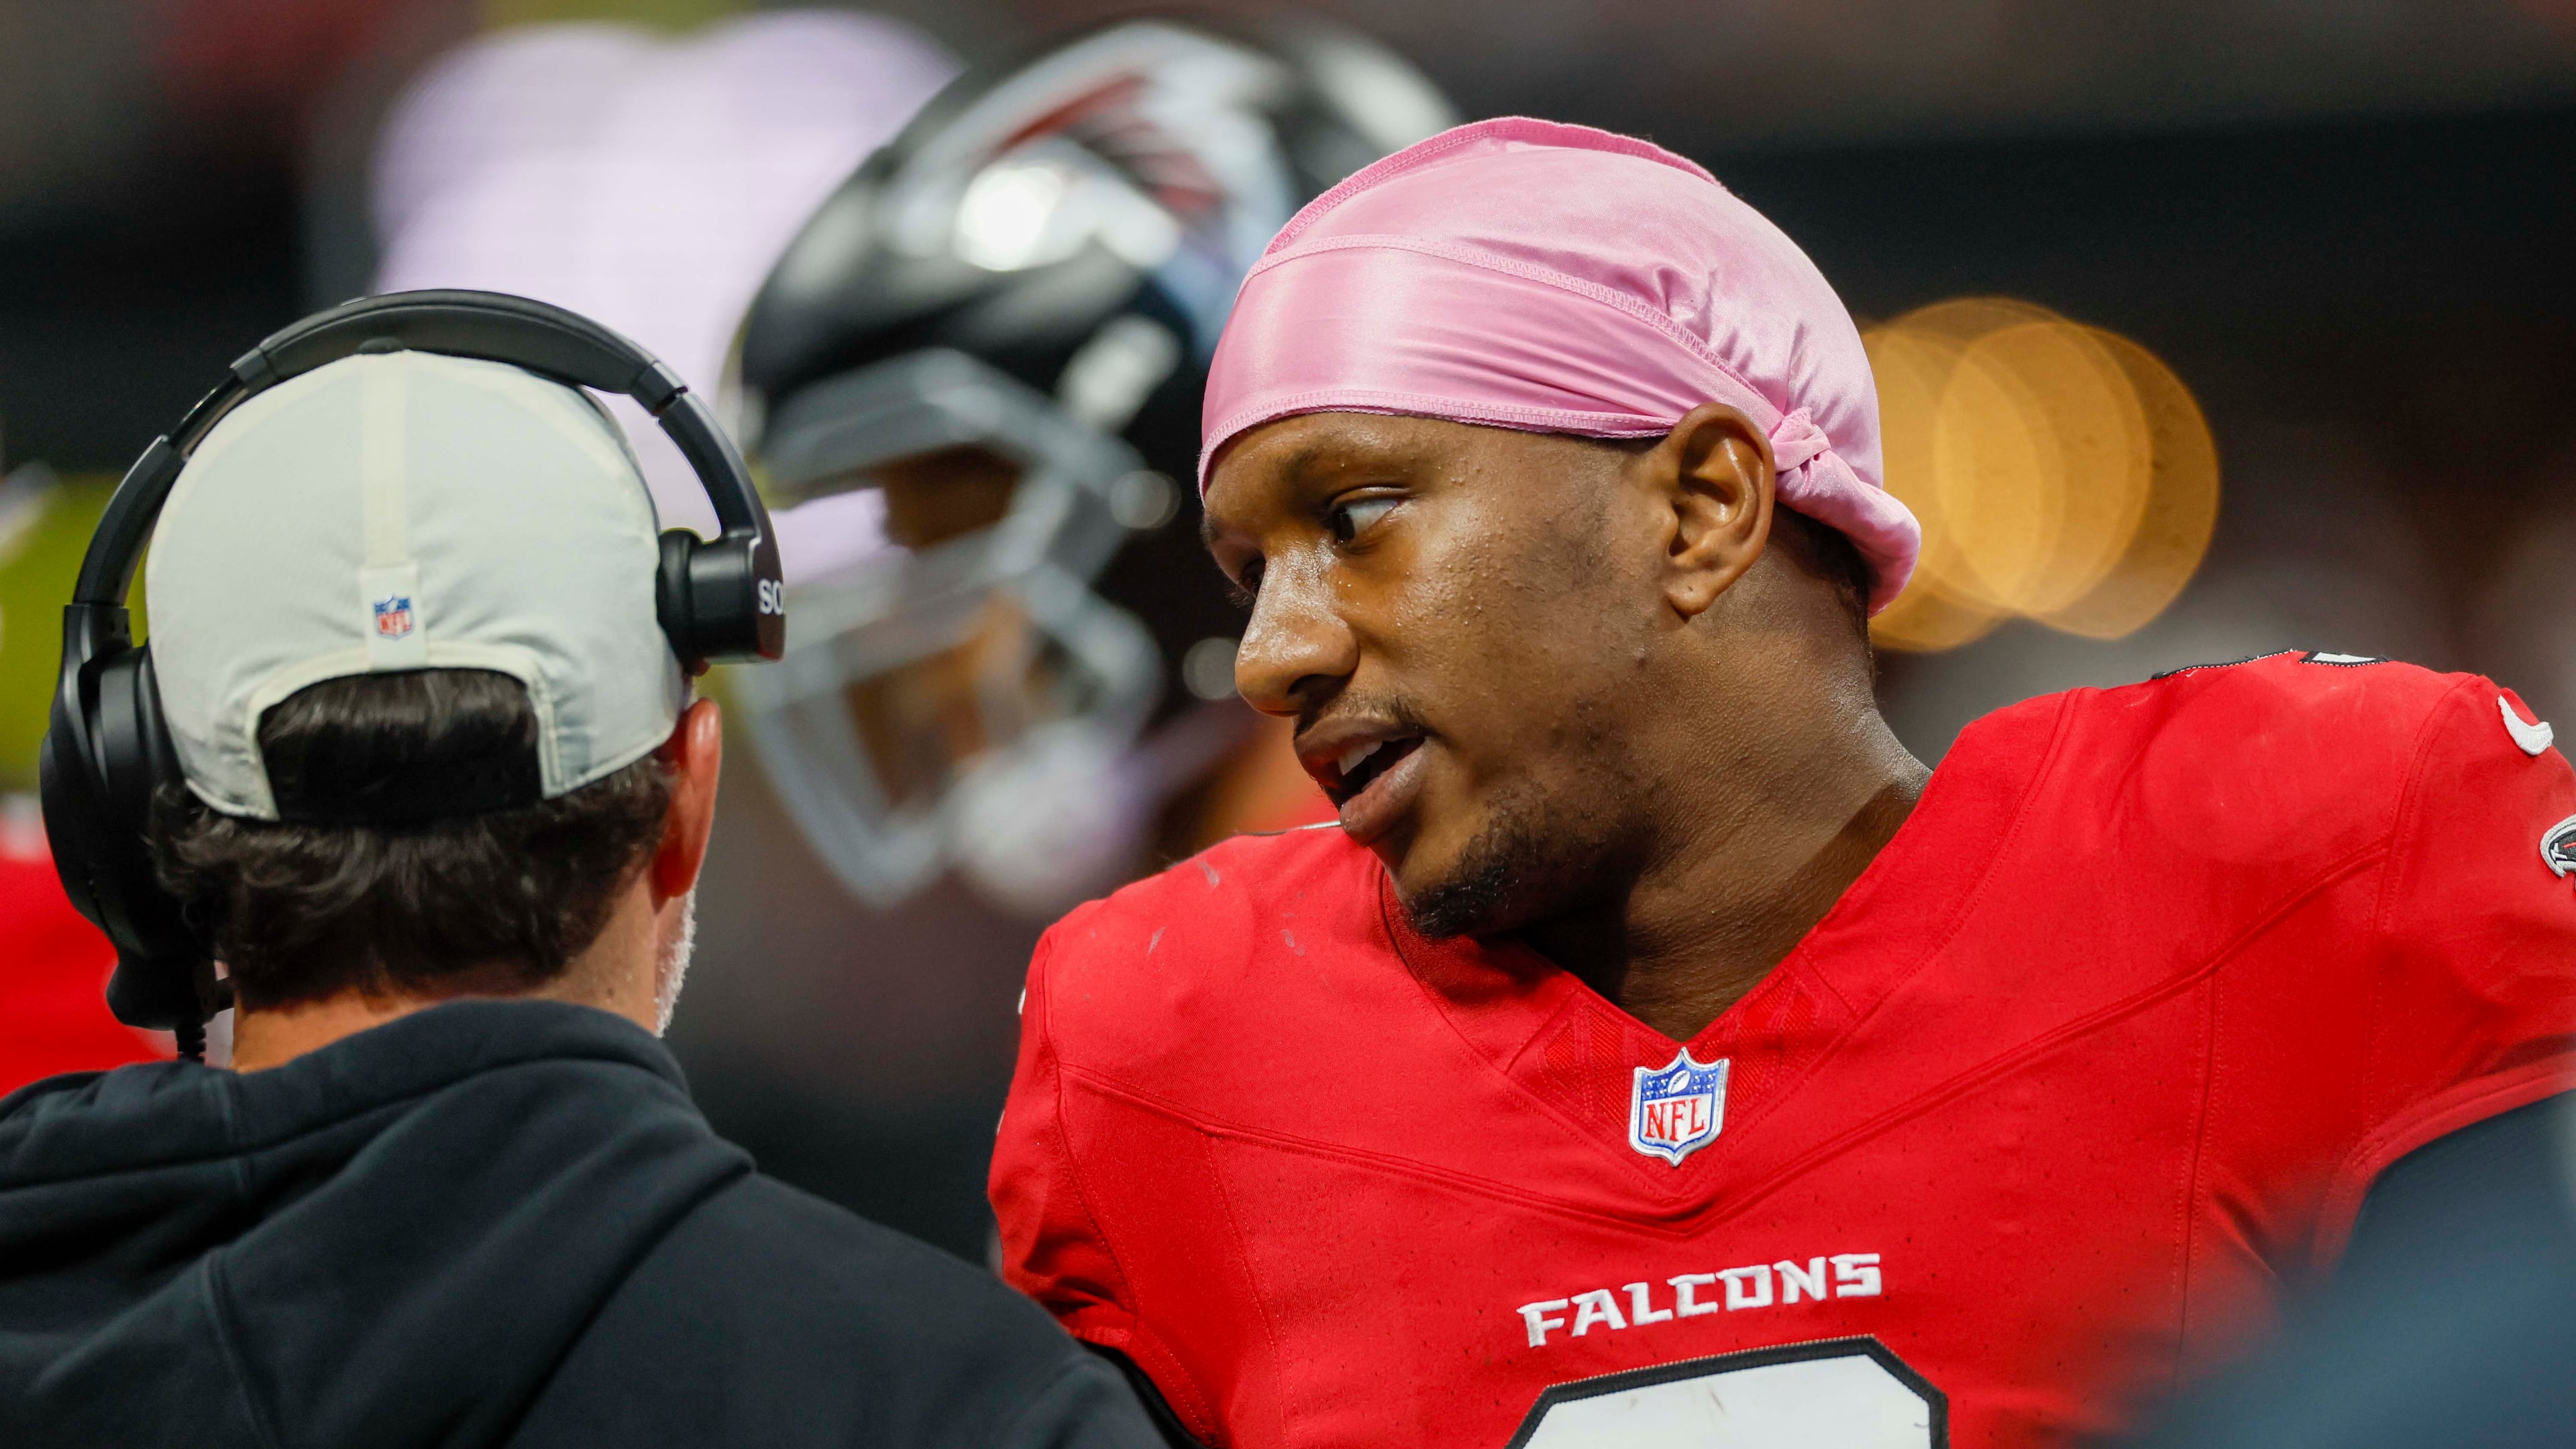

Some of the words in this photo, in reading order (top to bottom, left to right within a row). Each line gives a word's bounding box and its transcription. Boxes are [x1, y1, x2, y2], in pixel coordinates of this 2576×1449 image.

[378, 611, 412, 635] NFL
[1645, 1098, 1705, 1142] NFL
[1517, 1252, 1882, 1348] FALCONS
